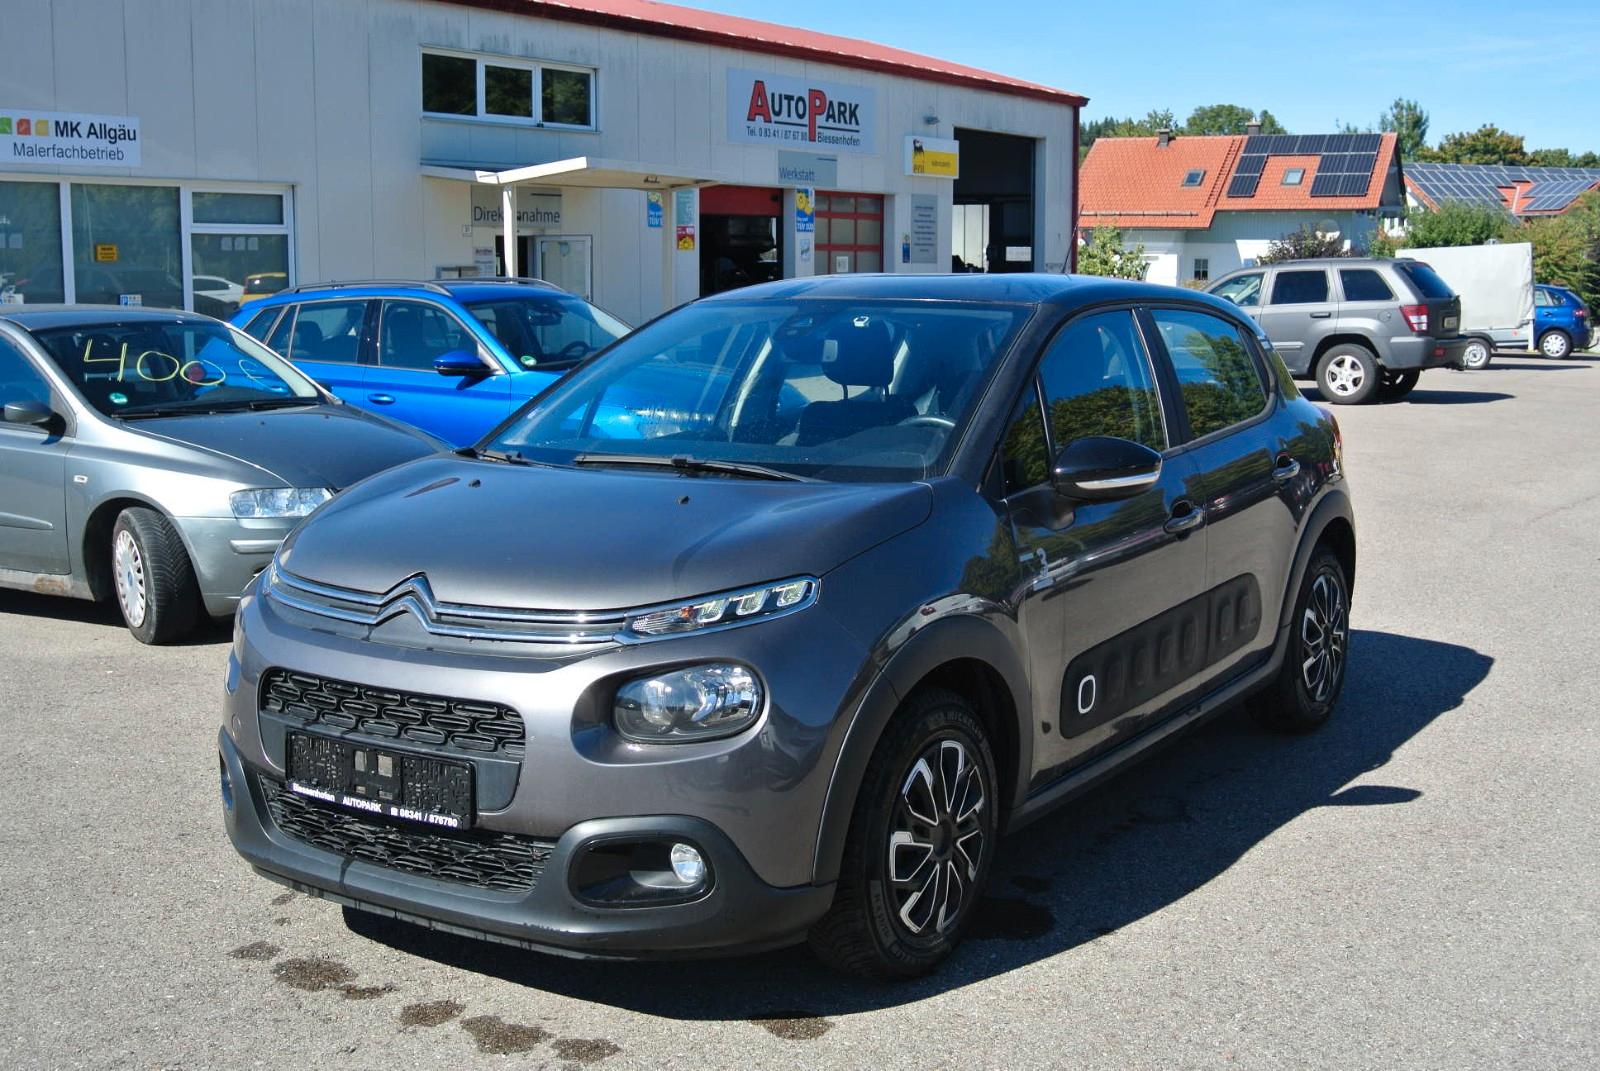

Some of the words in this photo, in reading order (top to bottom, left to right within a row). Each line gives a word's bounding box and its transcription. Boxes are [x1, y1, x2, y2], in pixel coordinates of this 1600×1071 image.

[55, 120, 82, 138] MK
[87, 123, 136, 144] Allgäu
[746, 126, 757, 136] Tel.
[817, 132, 861, 147] Biessenhofen
[13, 142, 124, 161] Malerfachbetrieb
[779, 167, 816, 182] Werkstatt
[342, 796, 382, 813] AUTOPARK
